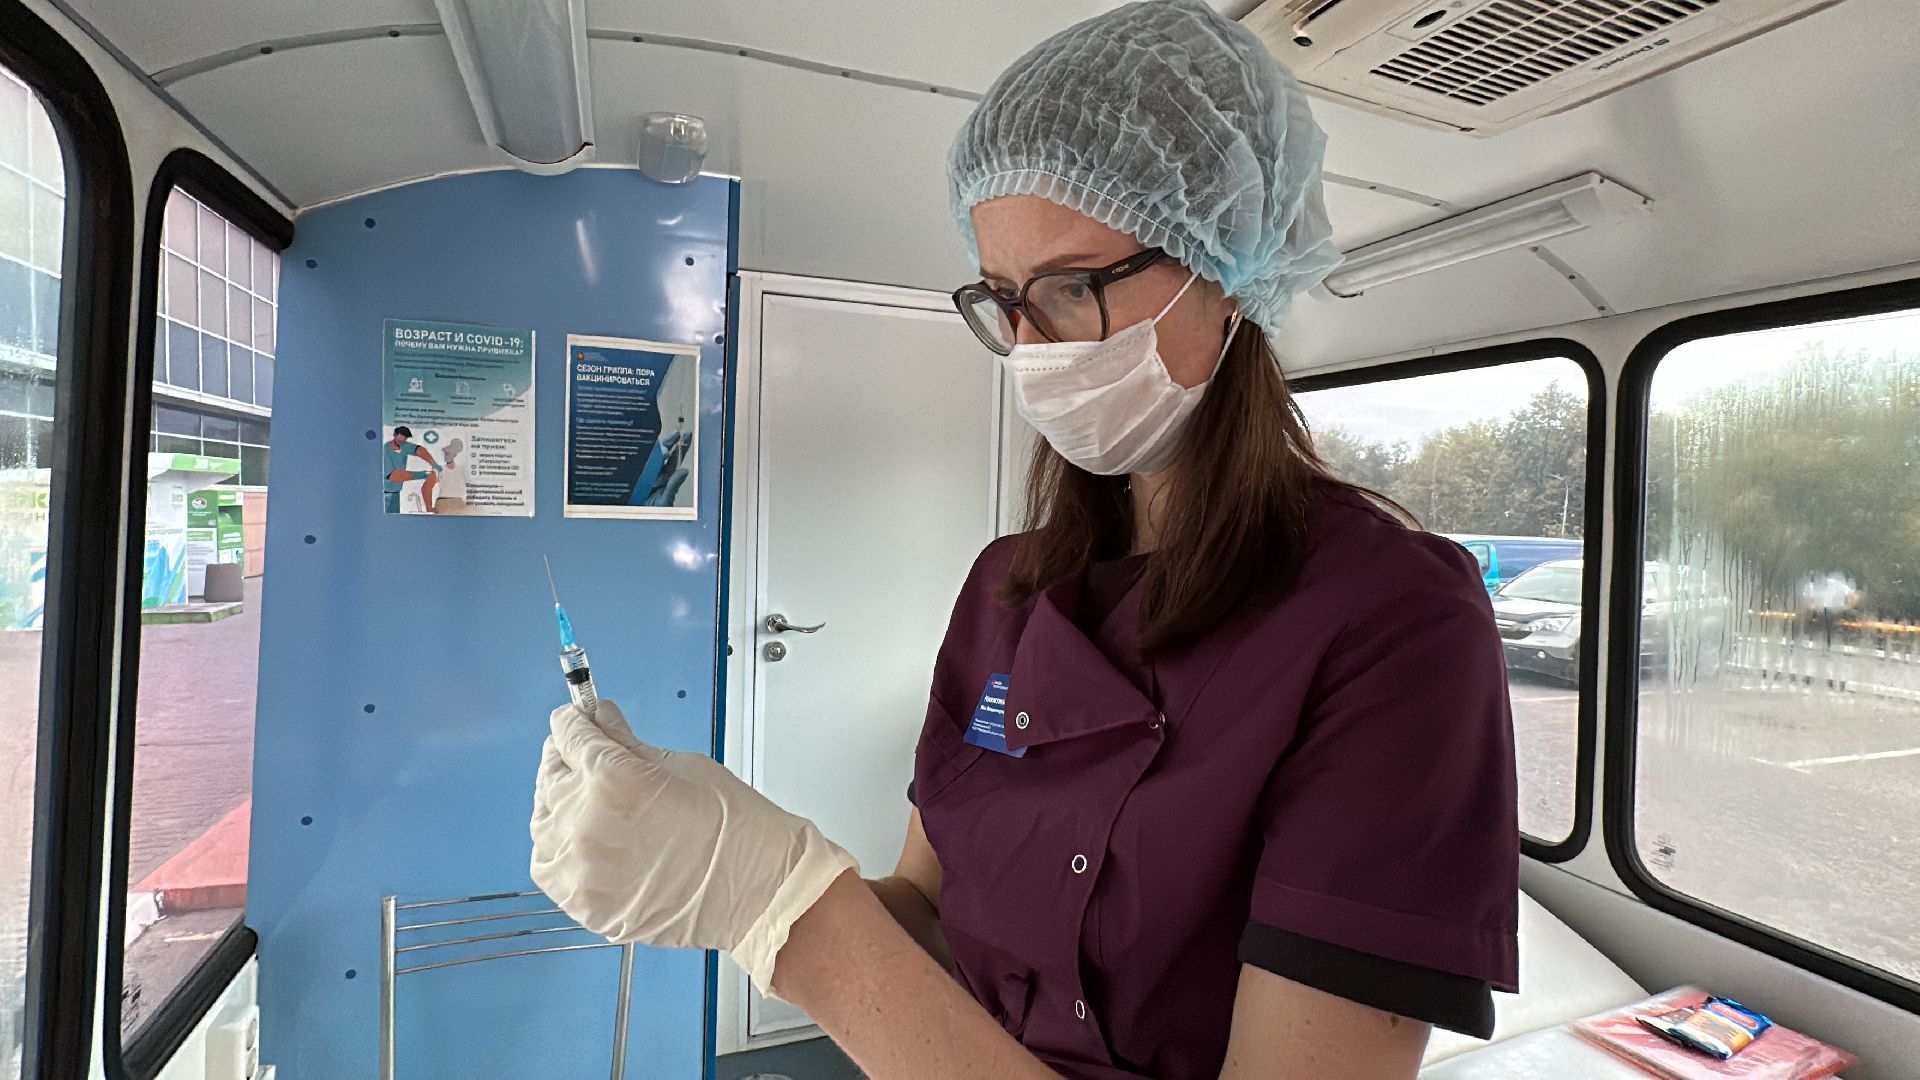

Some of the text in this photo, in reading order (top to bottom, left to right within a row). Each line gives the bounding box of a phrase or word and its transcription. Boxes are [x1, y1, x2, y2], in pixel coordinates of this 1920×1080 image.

[395, 328, 452, 341] ВОЗРАСТ
[454, 332, 463, 342] И
[395, 340, 427, 349] ПОЧЕМУ
[446, 343, 476, 352] НУЖНА
[577, 364, 602, 373] СЕЗОН
[635, 368, 655, 377] ПОРА
[576, 374, 650, 386] ВАКЦИНИРОВАТЬСЯ
